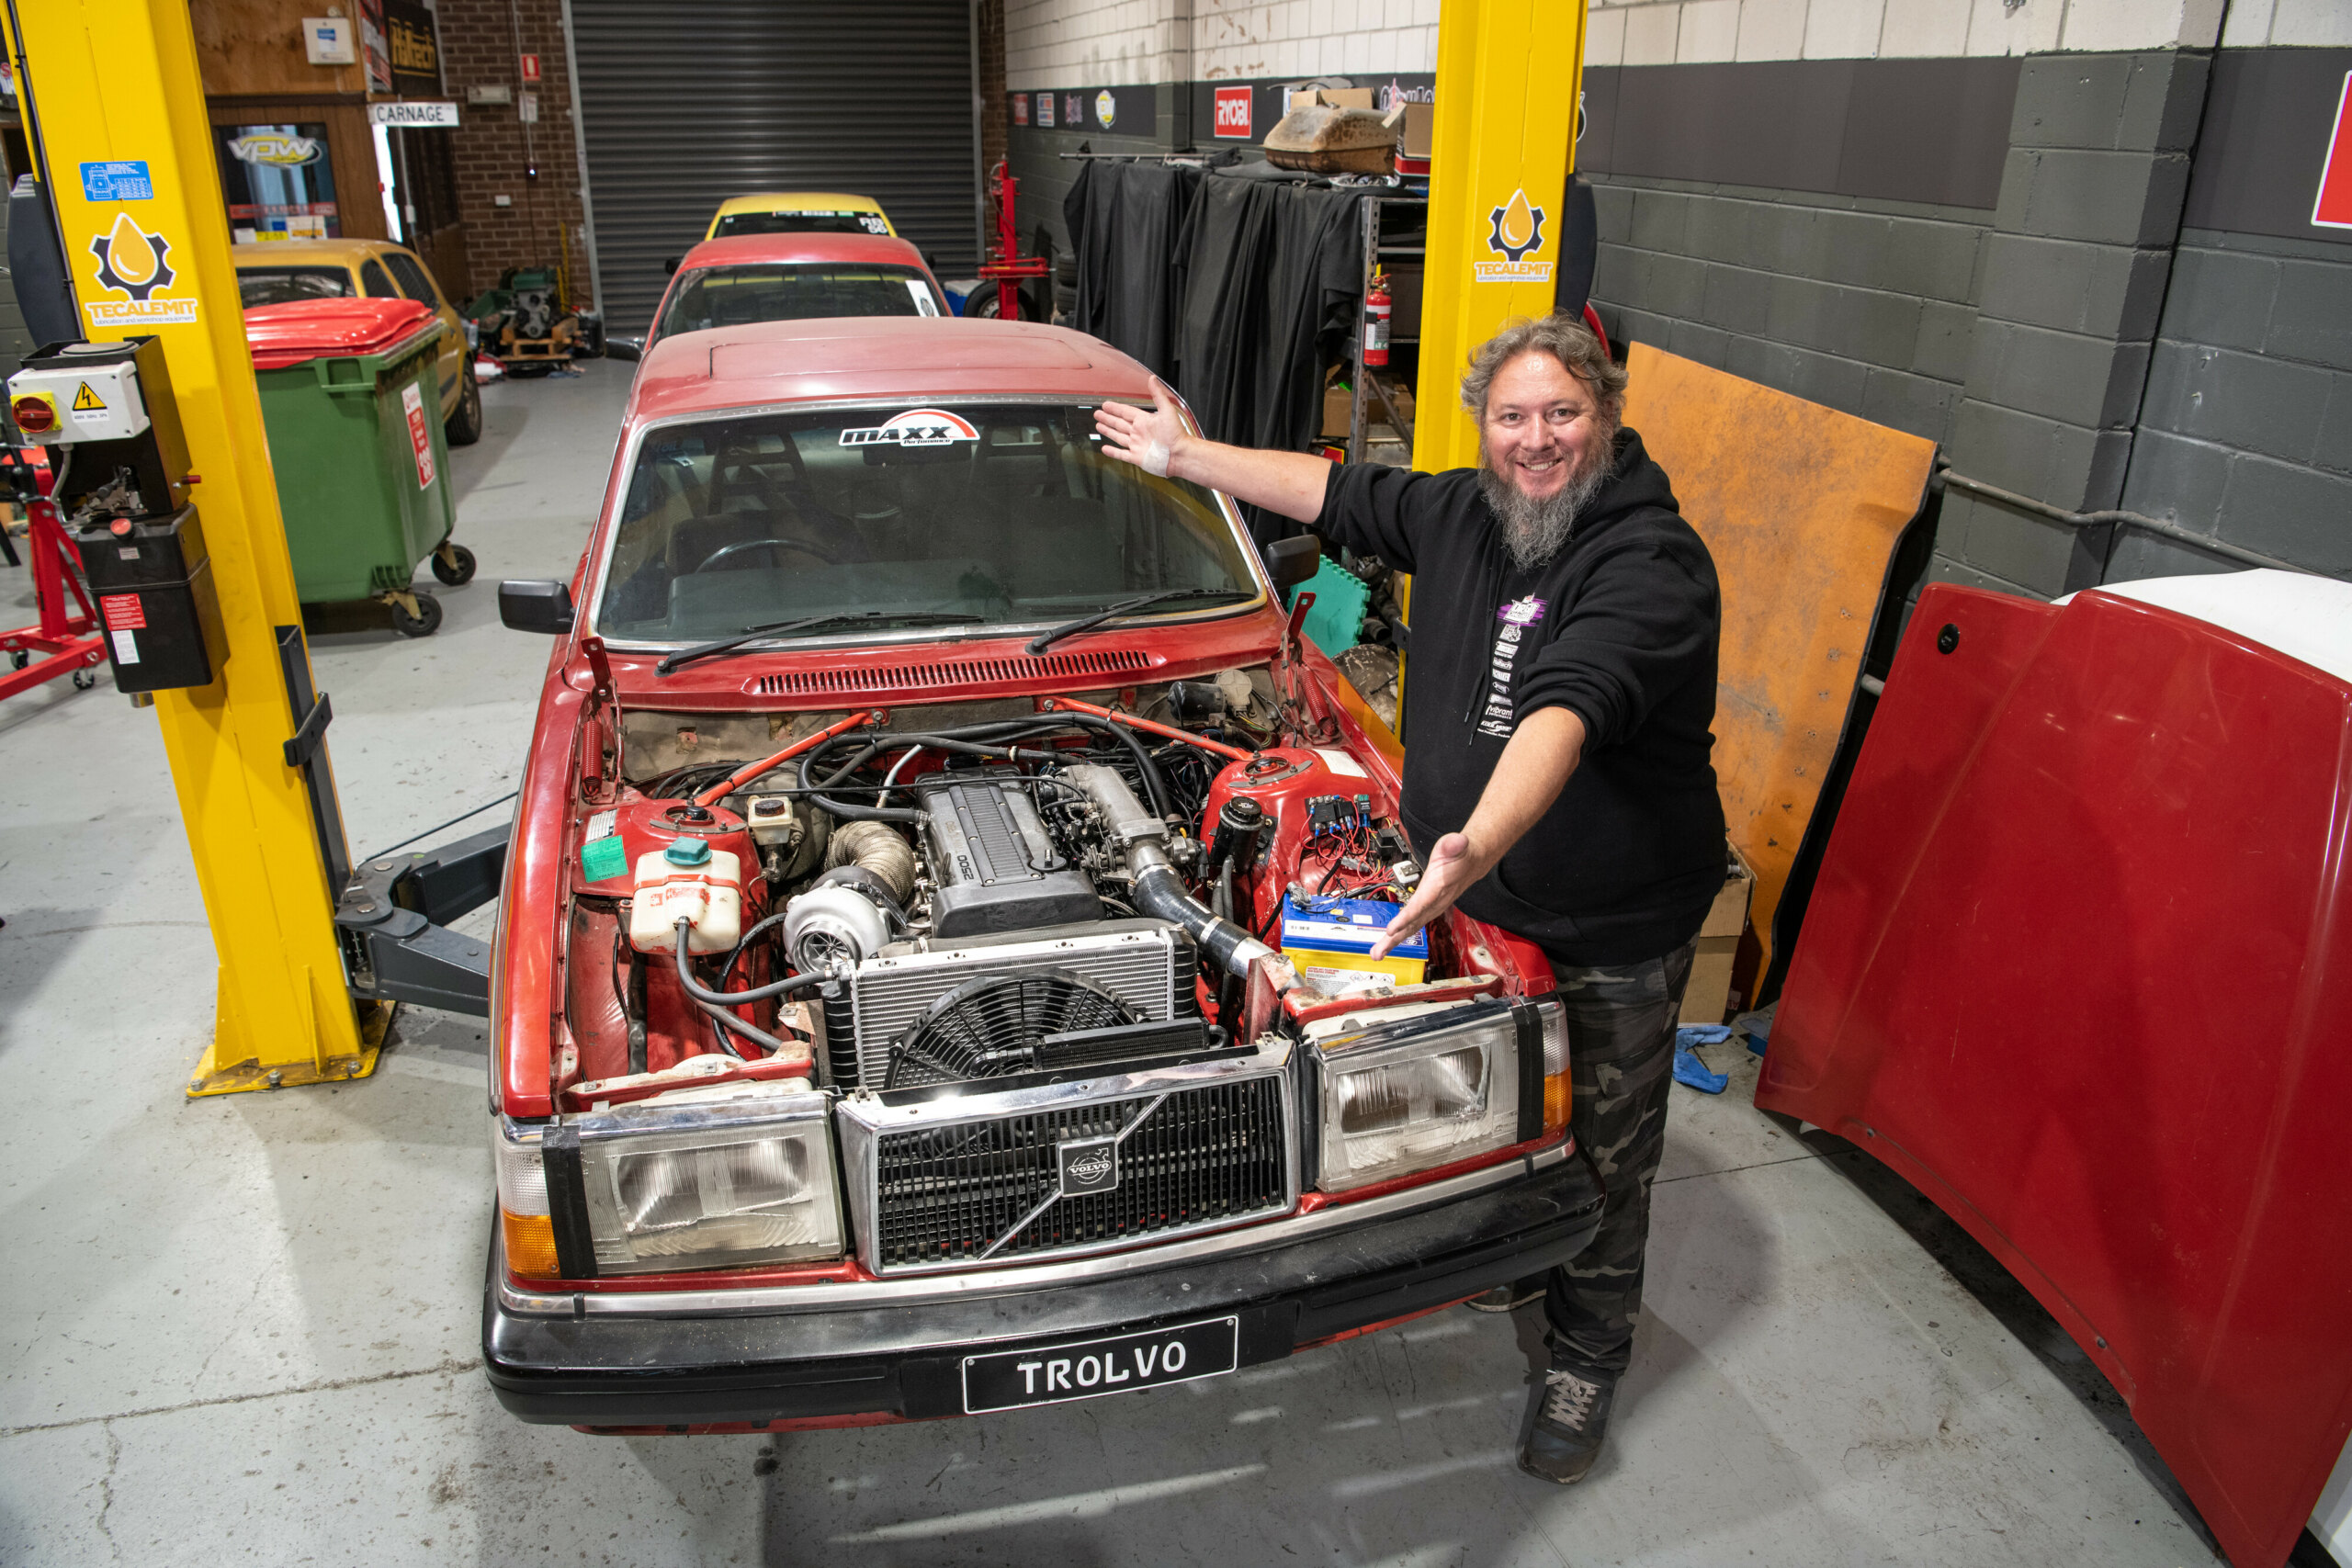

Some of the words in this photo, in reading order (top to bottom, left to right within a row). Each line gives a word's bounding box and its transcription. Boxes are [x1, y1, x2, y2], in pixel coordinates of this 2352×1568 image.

[376, 106, 445, 121] CARNAGE
[1217, 99, 1250, 126] RYOBI
[1476, 263, 1552, 276] TECALEMIT
[88, 300, 196, 319] TECALEMIT
[1489, 705, 1512, 716] vibrant
[957, 854, 974, 880] 2500
[1069, 1163, 1110, 1174] VOLVO
[1017, 1341, 1186, 1394] TROLVO
